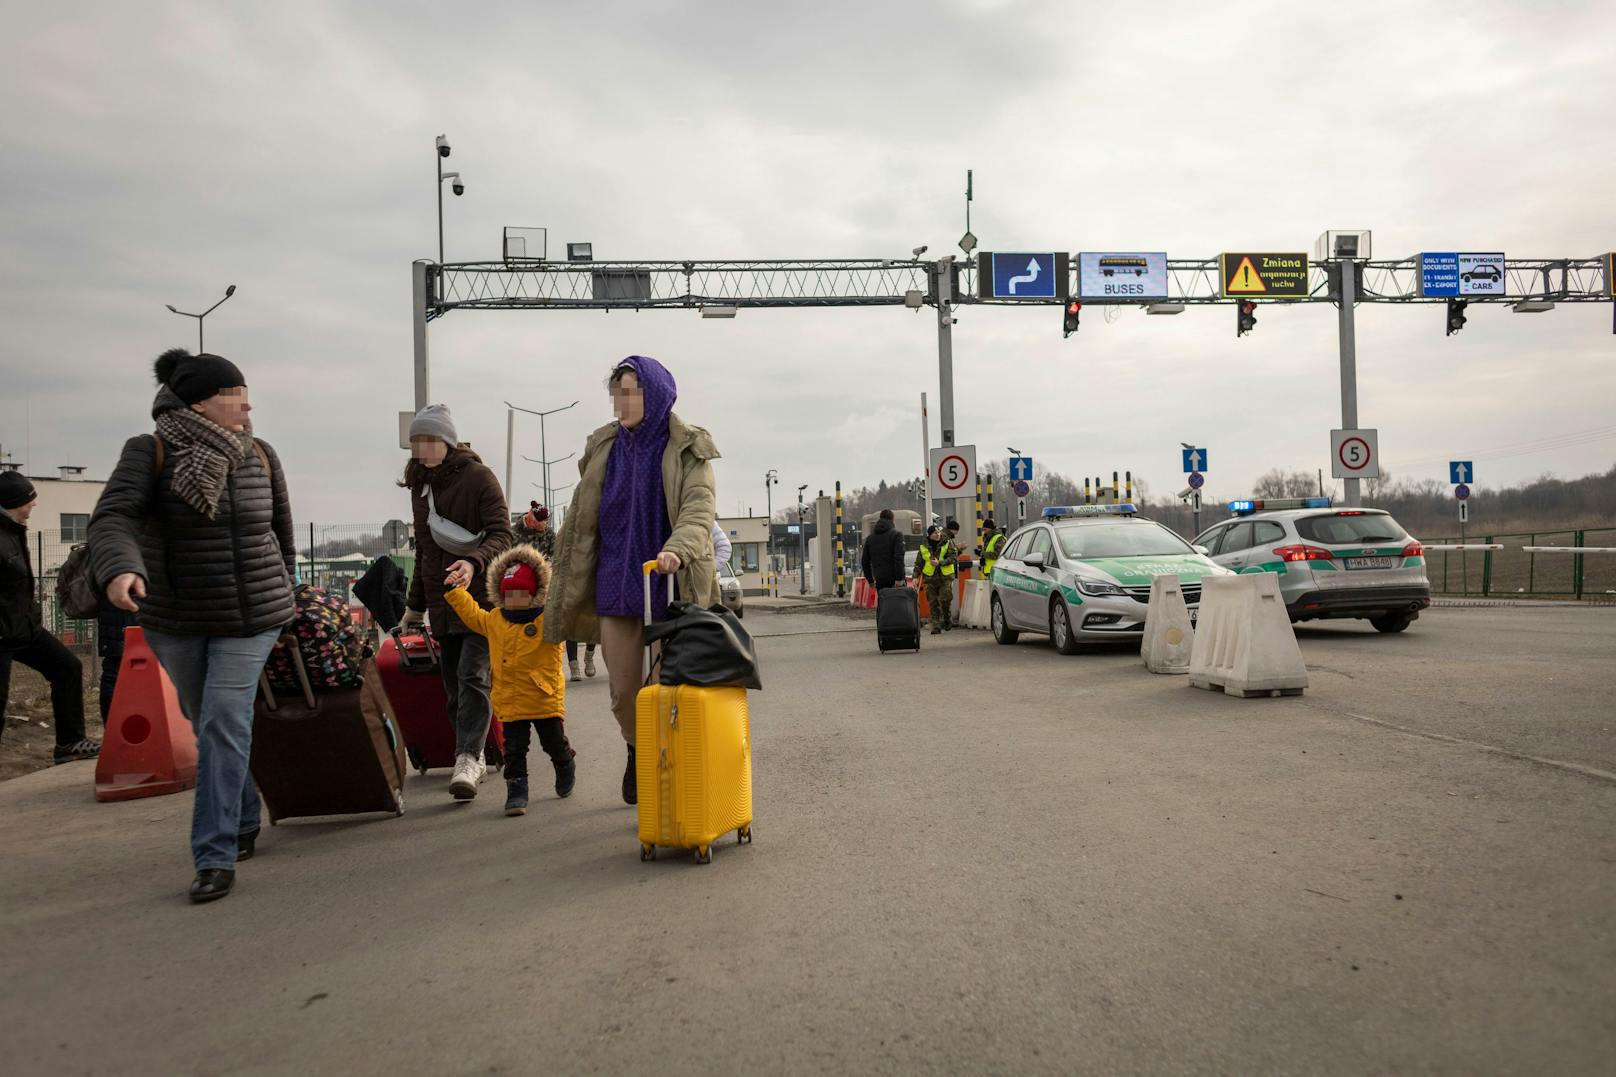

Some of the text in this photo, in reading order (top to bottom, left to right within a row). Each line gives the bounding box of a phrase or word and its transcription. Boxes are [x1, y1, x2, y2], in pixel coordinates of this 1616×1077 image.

[1262, 257, 1301, 268] Zmiana
[1104, 284, 1144, 294] BUSES
[1350, 446, 1360, 462] 5
[949, 465, 958, 482] 5
